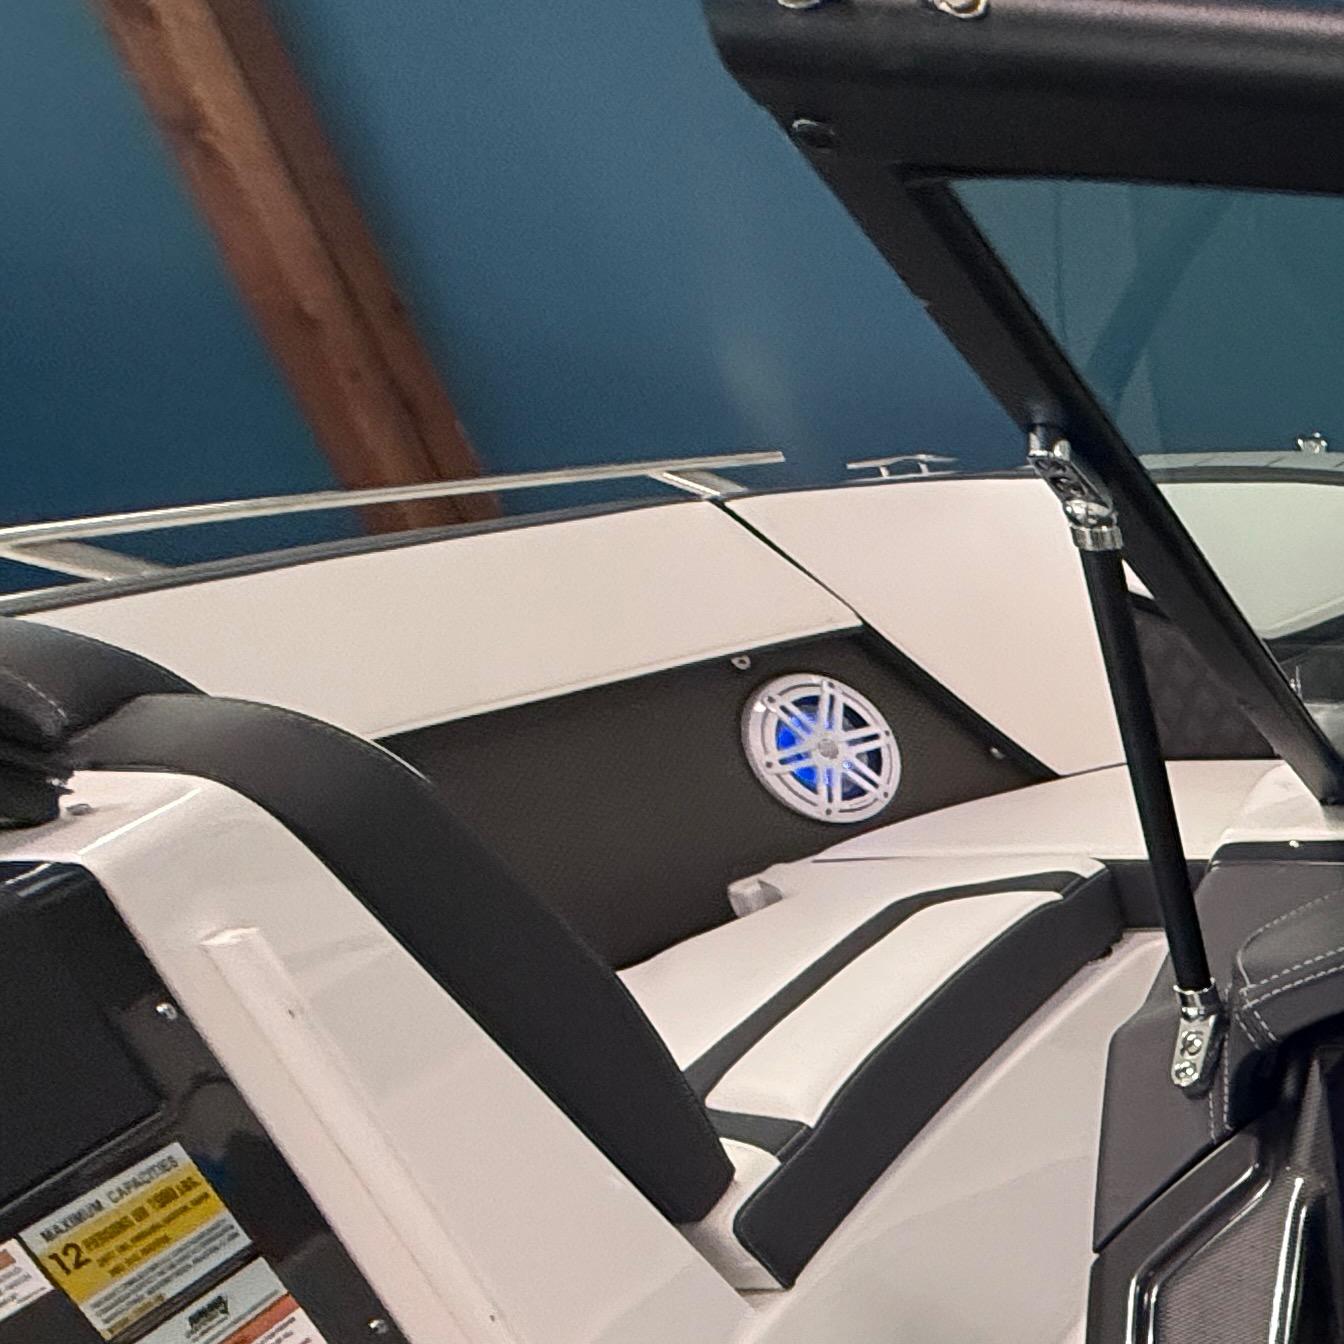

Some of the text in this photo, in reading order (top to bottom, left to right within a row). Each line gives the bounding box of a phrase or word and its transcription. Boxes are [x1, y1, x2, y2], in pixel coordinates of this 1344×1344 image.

[40, 1199, 105, 1243] MAXIMUM
[107, 1154, 179, 1204] CAPACITIES
[48, 1242, 92, 1276] 12
